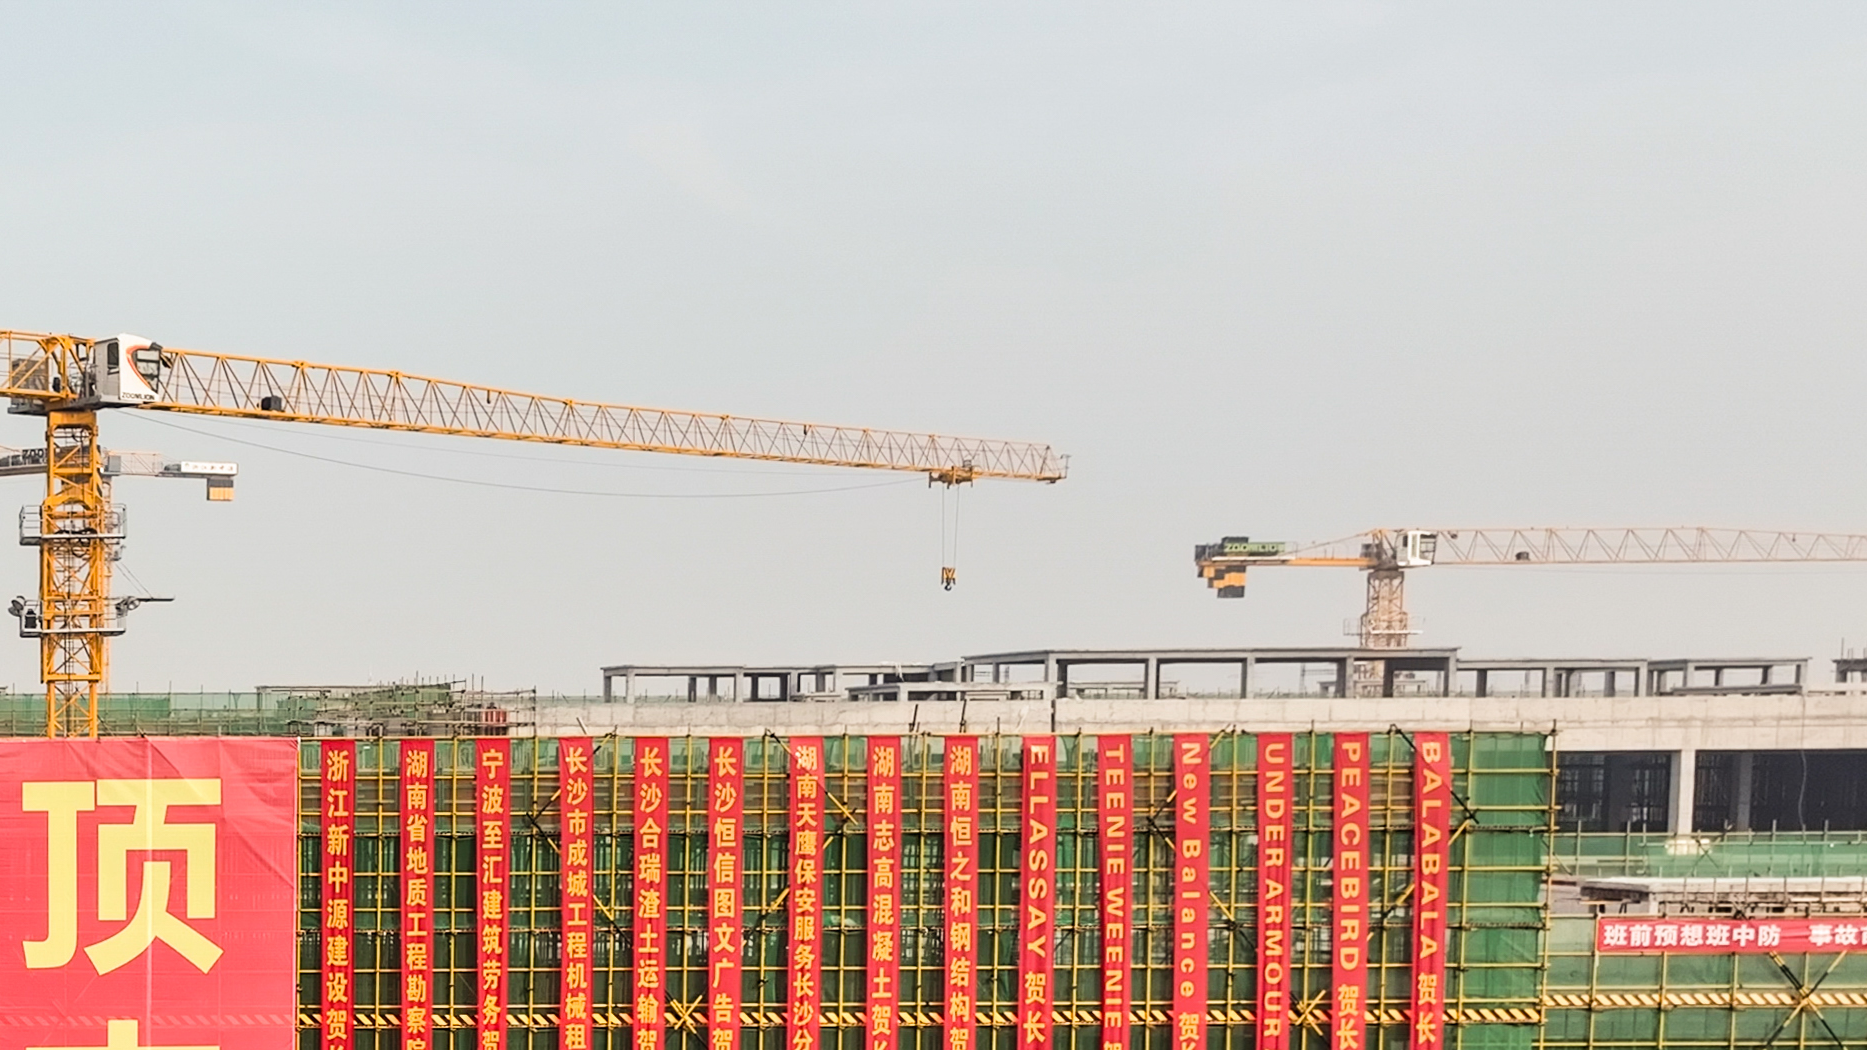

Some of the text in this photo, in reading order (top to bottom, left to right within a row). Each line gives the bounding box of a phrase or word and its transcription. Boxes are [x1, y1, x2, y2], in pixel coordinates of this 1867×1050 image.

[1027, 744, 1050, 958] ELLASSAY
[1105, 743, 1125, 875] TEENIE
[1181, 742, 1202, 824] New
[1264, 743, 1285, 867] UNDER
[1339, 742, 1361, 971] PEACEBIRD
[1419, 741, 1443, 959] BALABALA
[1104, 886, 1125, 1028] WEENIE
[1180, 839, 1202, 998] Balance
[1263, 878, 1284, 1037] ARMOUR
[1604, 924, 1867, 947] 班前预想班中防 事故
